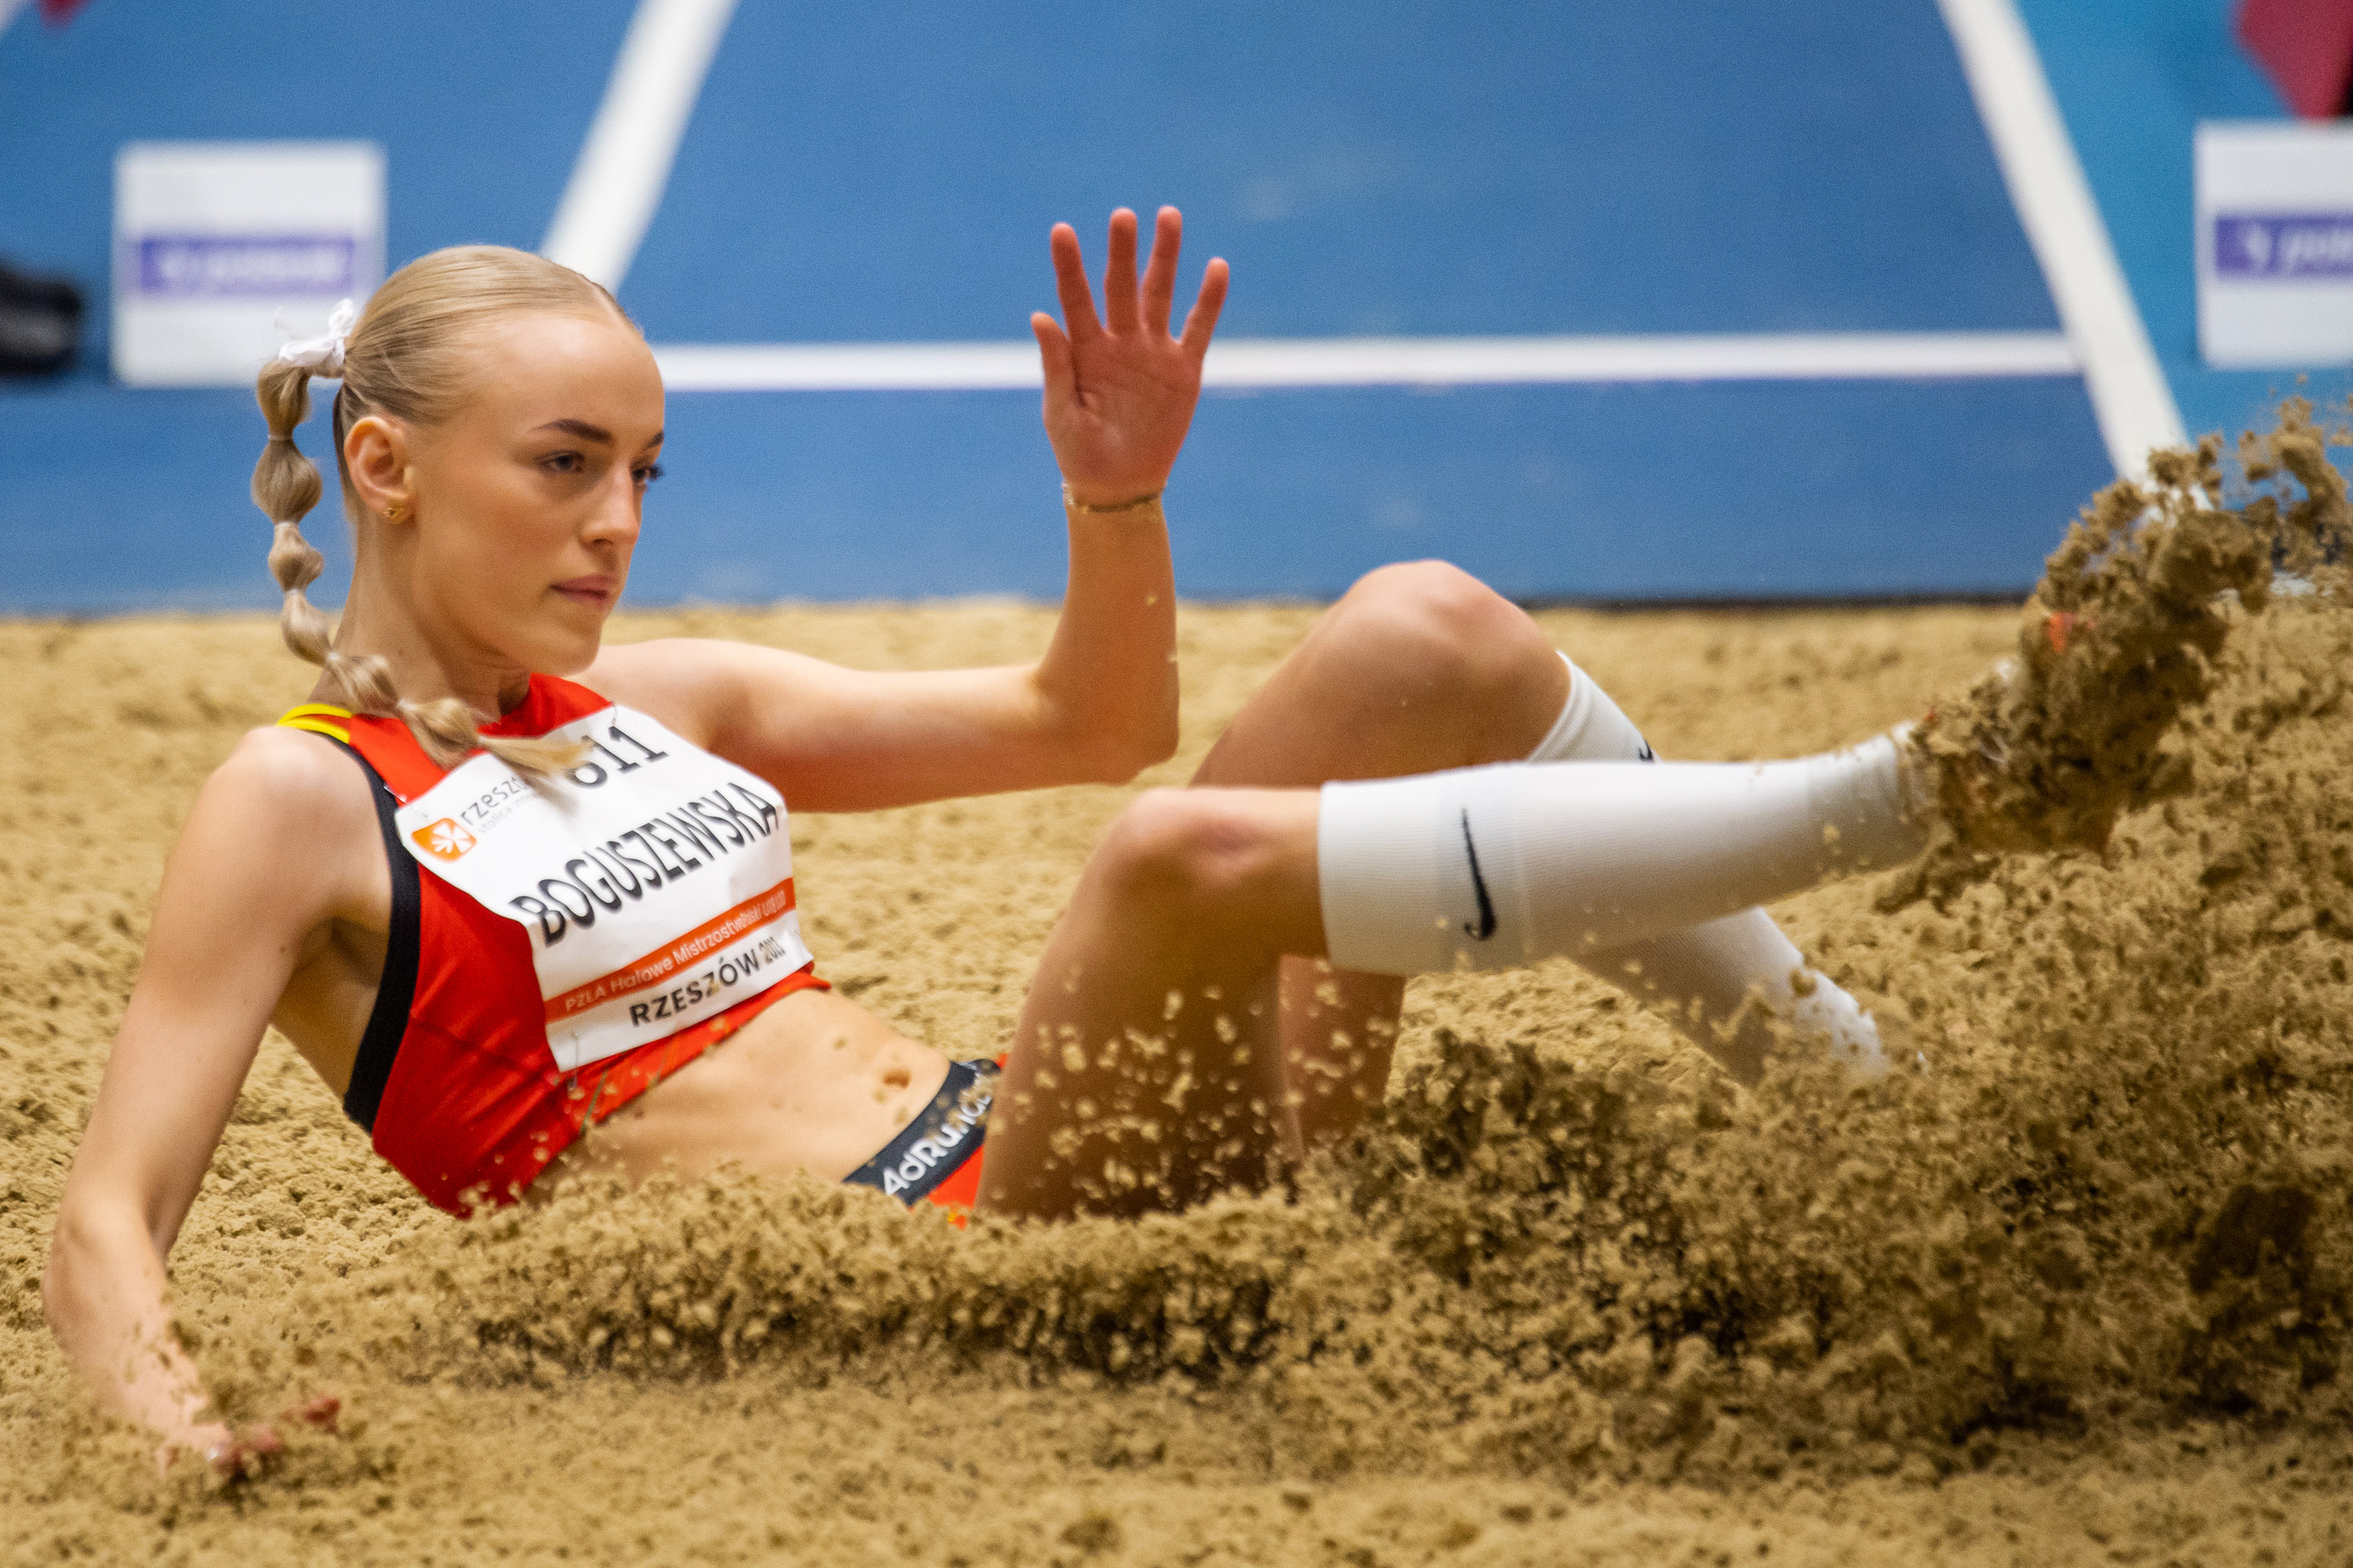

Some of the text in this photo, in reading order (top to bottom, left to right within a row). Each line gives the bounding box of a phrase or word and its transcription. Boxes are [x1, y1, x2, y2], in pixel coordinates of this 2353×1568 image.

[460, 776, 529, 826] rzesz
[509, 782, 779, 948] BOGUSZEWSKA
[609, 955, 674, 1000] Halowe
[629, 948, 759, 1027] RZESZÓW
